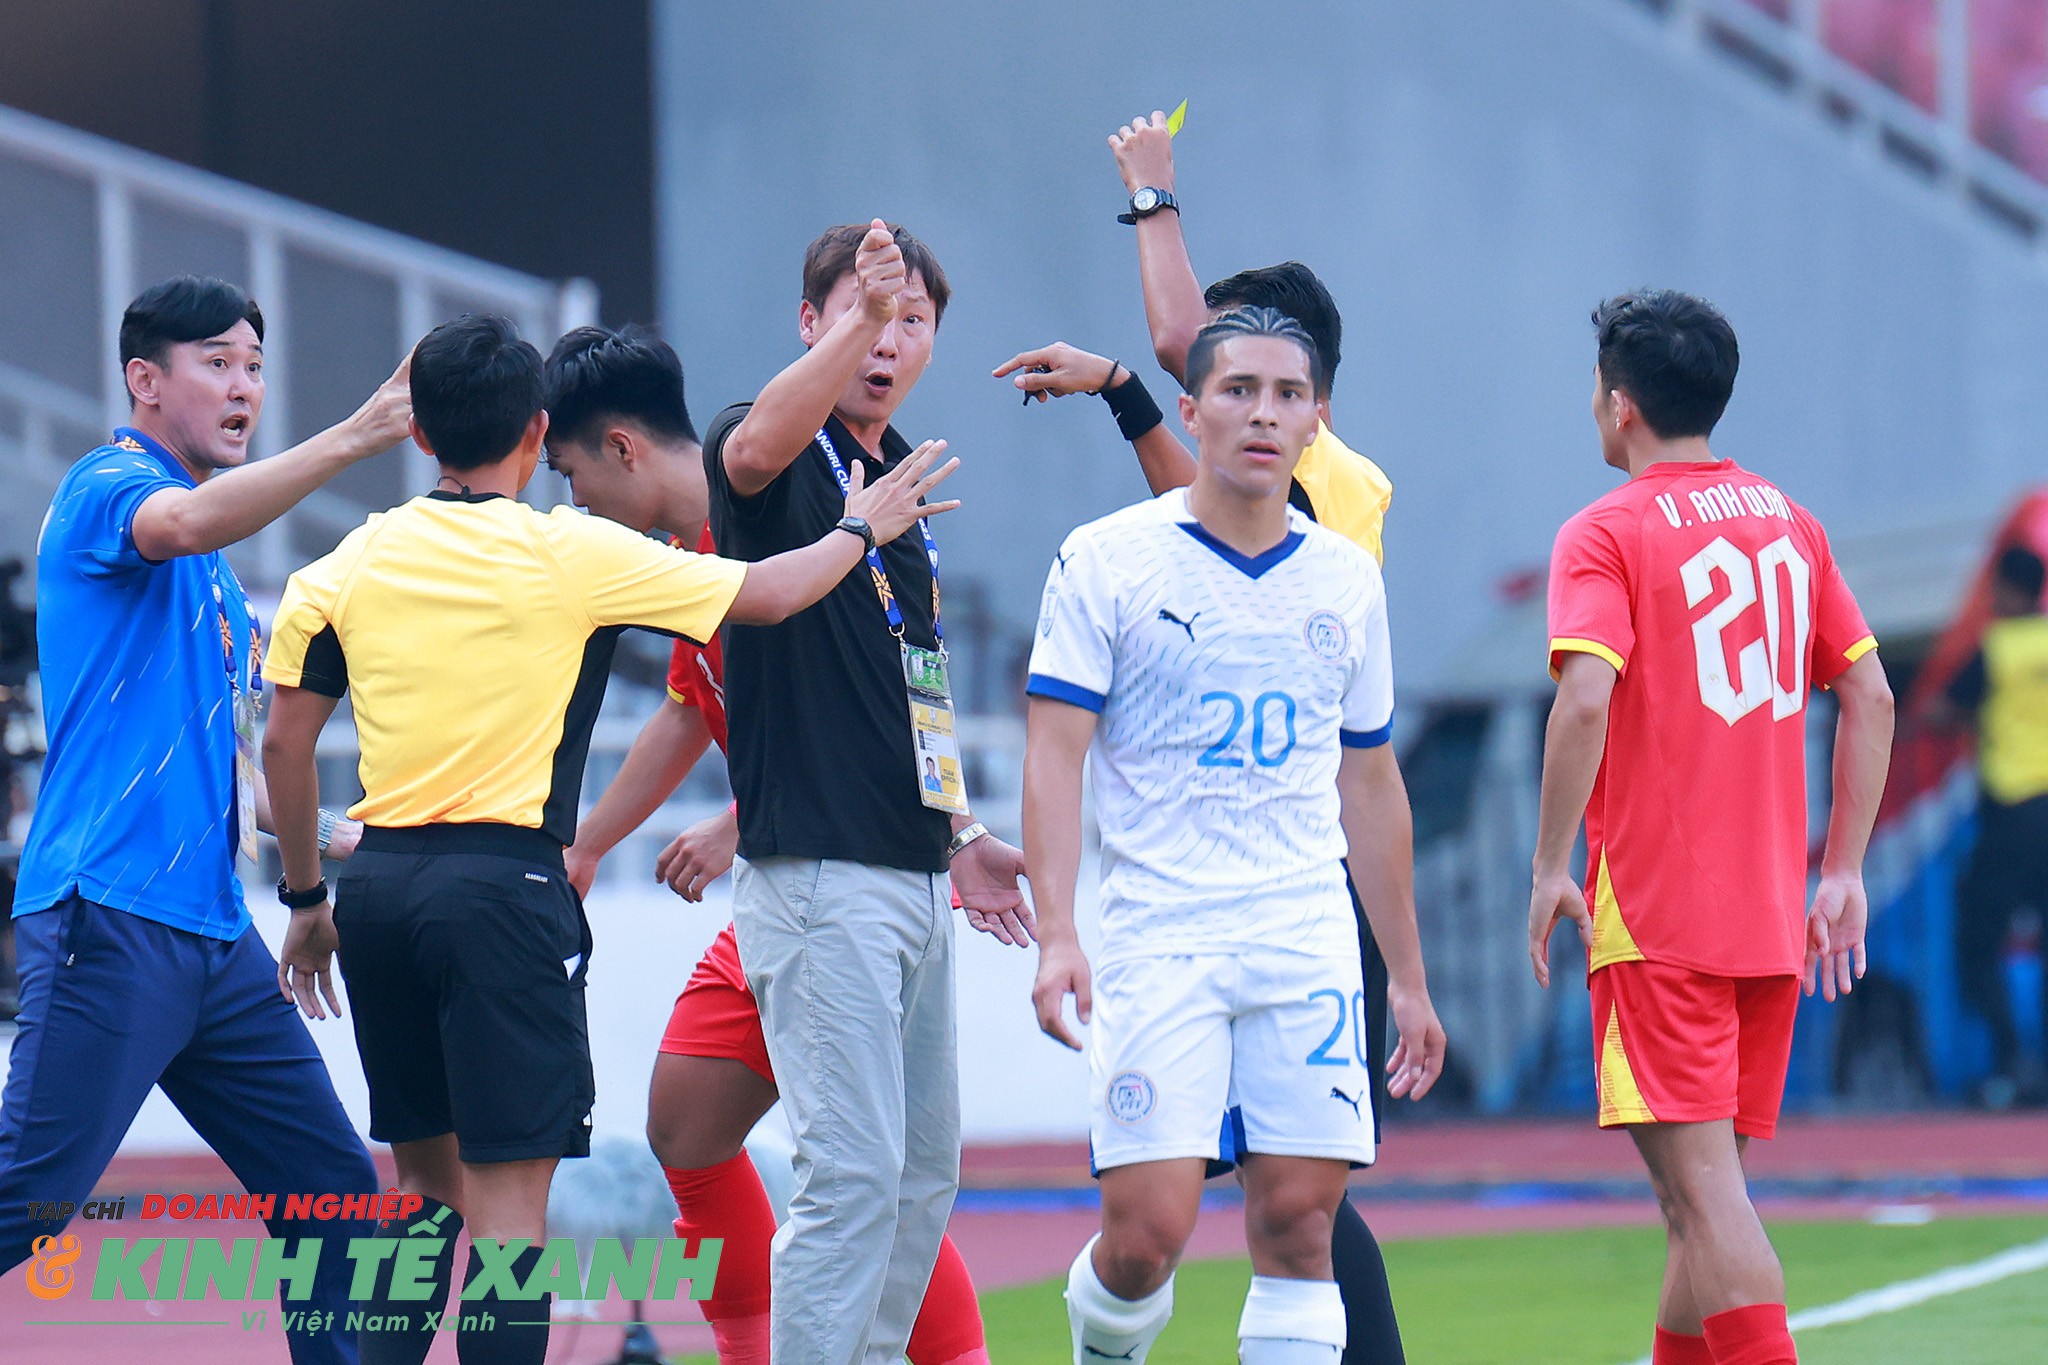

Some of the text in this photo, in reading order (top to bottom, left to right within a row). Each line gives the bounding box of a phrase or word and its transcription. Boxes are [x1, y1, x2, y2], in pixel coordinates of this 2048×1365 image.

[814, 428, 842, 468] ANDIRI
[918, 517, 933, 541] 025
[1654, 492, 1693, 529] V.
[1688, 482, 1747, 523] ANH
[1679, 534, 1811, 728] 20
[1197, 690, 1297, 768] 20
